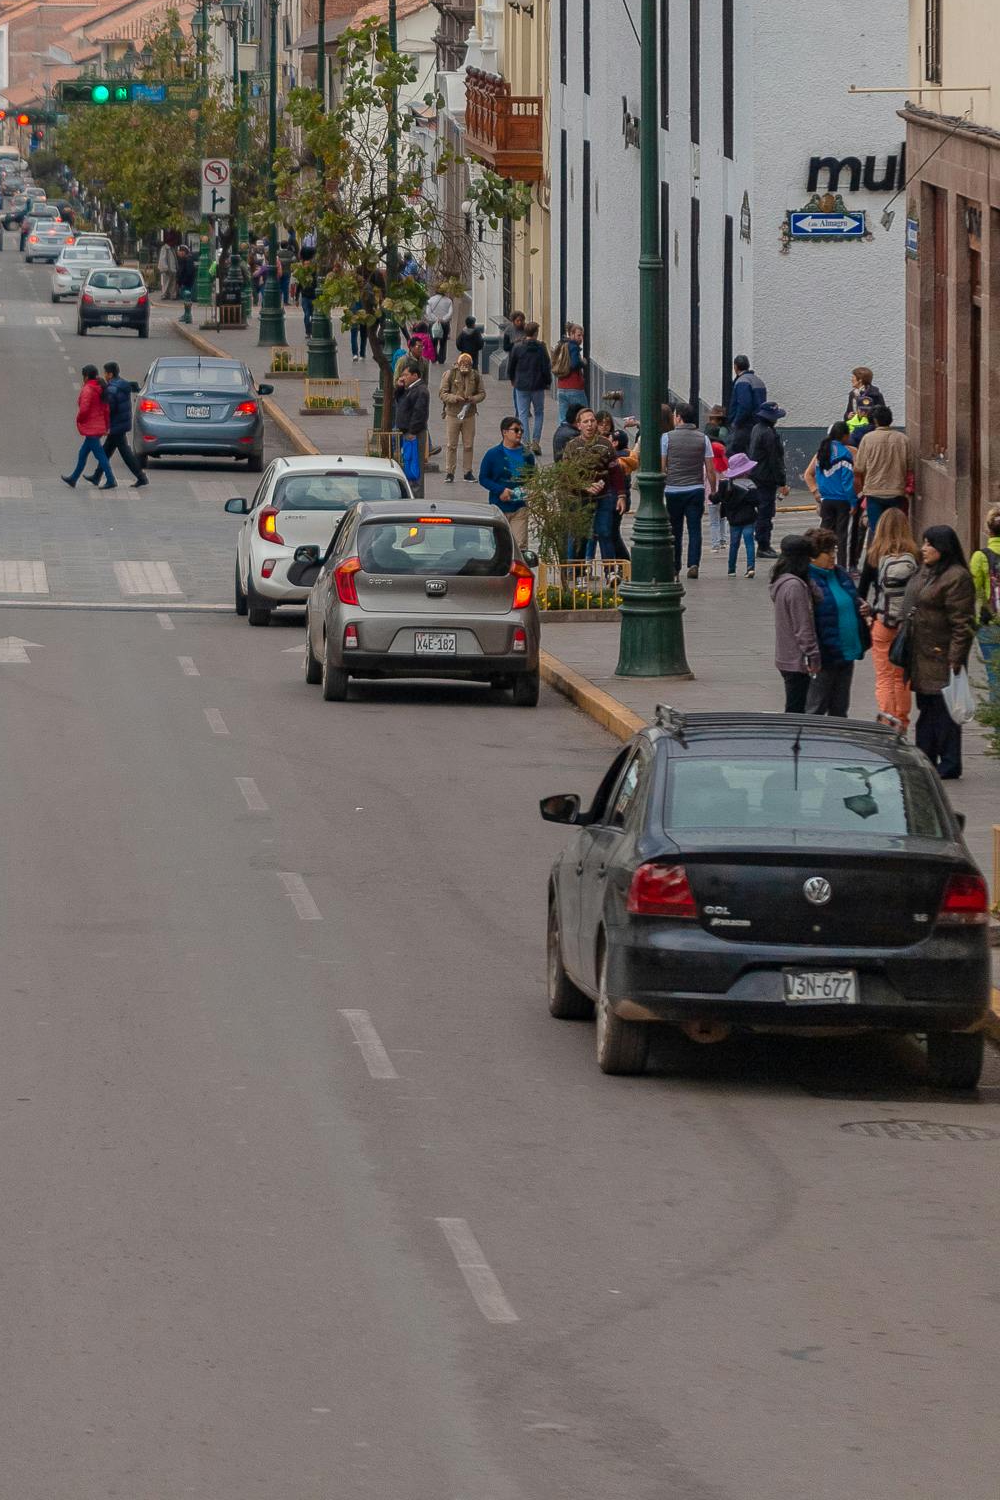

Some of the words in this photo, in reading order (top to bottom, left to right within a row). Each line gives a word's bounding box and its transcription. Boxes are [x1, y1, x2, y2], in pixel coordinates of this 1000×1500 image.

[820, 219, 848, 228] Almagro
[417, 638, 455, 650] X4E-182
[704, 905, 731, 915] GOL
